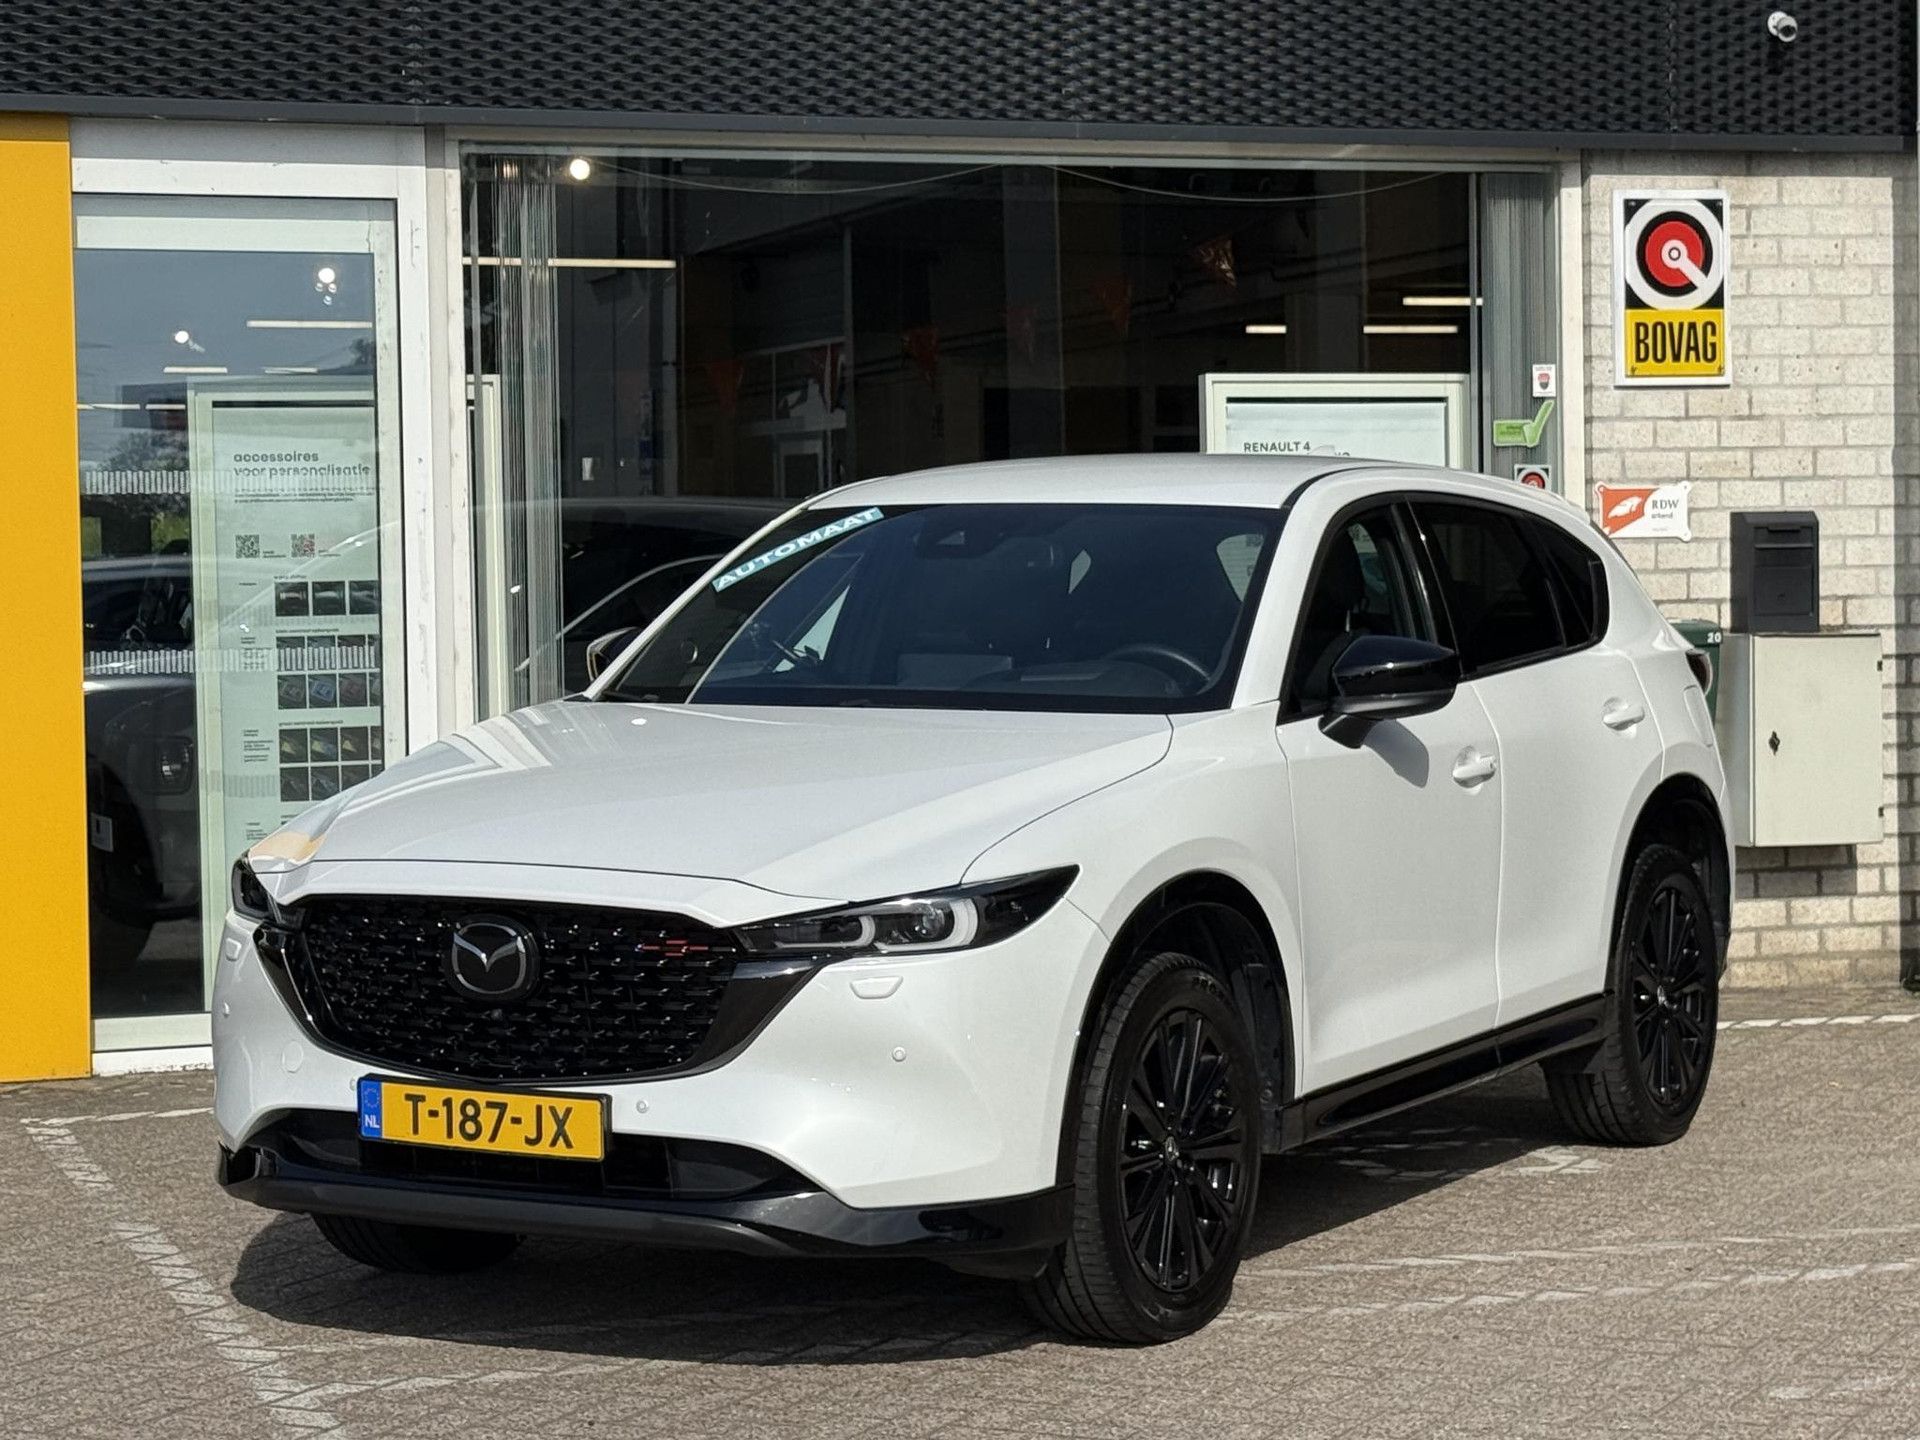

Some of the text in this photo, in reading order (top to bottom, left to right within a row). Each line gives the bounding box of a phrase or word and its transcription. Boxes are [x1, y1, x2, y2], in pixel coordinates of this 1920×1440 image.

[1635, 320, 1717, 363] BOVAG
[1243, 441, 1311, 452] RENAULT 4
[233, 450, 319, 462] accessoires
[233, 463, 371, 480] voor personalisatie
[1651, 499, 1680, 510] RDW
[716, 509, 876, 590] AUTOMAAT
[1707, 631, 1722, 643] 20
[364, 1114, 380, 1128] NL
[403, 1093, 574, 1150] T-187-JX
